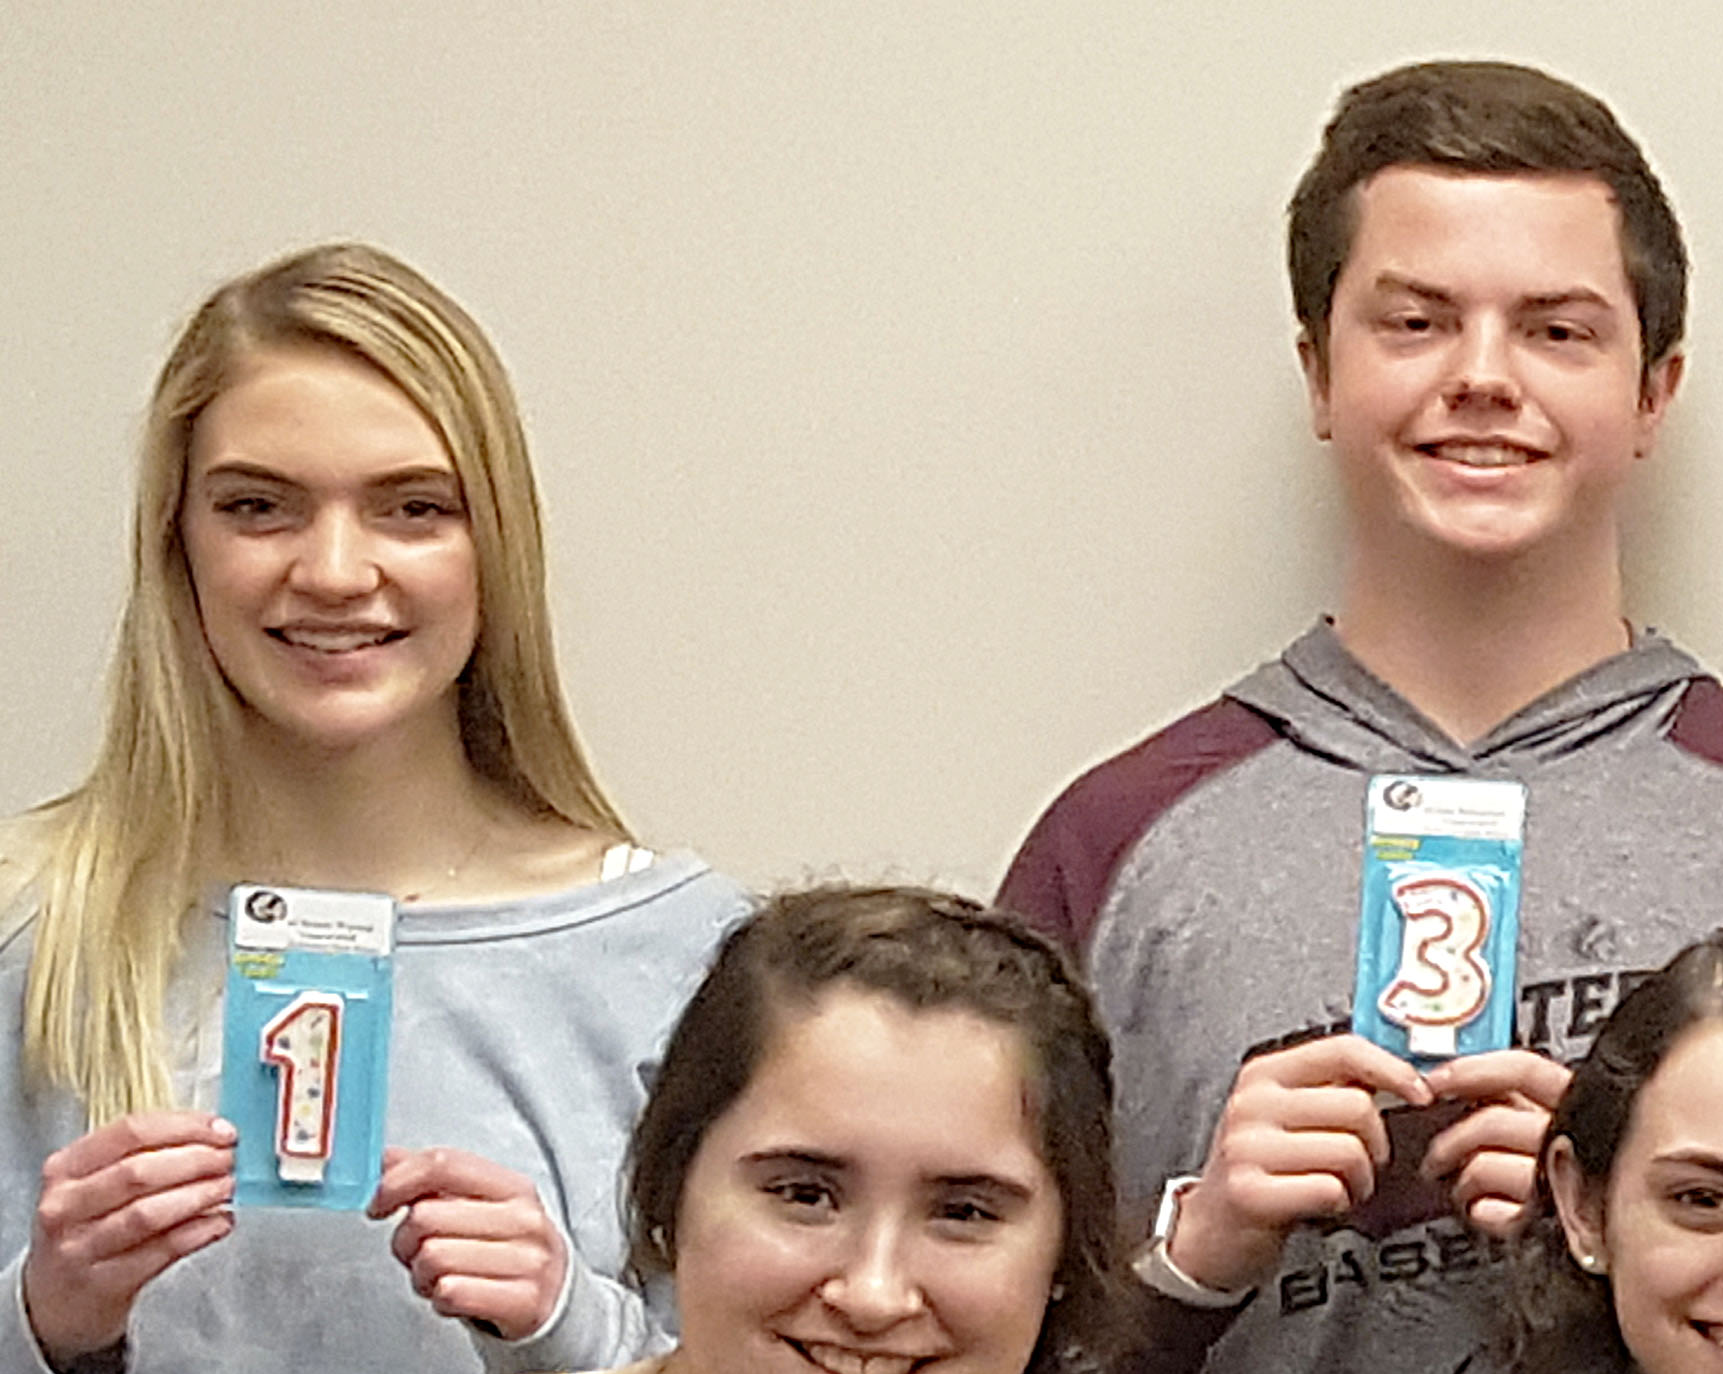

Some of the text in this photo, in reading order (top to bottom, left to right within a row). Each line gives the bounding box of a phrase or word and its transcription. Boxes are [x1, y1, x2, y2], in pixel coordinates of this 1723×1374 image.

[1377, 873, 1491, 1027] 3
[260, 991, 344, 1158] 1
[1279, 1226, 1508, 1317] BASE
